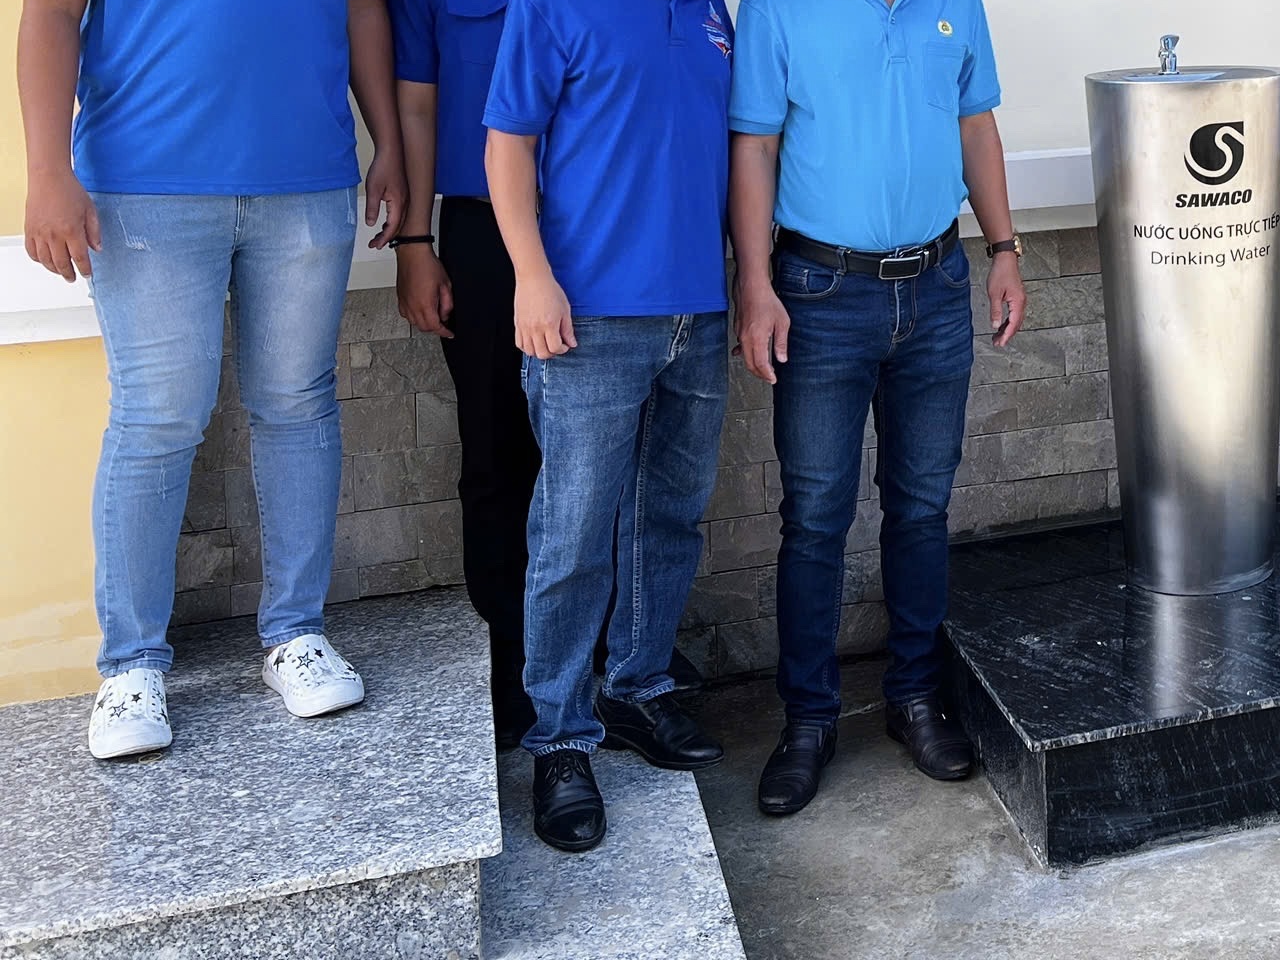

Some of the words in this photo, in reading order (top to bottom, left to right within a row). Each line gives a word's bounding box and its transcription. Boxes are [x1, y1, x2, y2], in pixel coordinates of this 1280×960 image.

[1175, 189, 1253, 208] SAWACO
[1133, 224, 1174, 240] NƯỚC
[1178, 222, 1224, 240] UỐNG
[1226, 220, 1261, 238] TRỰC
[1262, 213, 1280, 232] TIẾP
[1151, 251, 1226, 268] Drinking
[1230, 244, 1271, 262] Water
